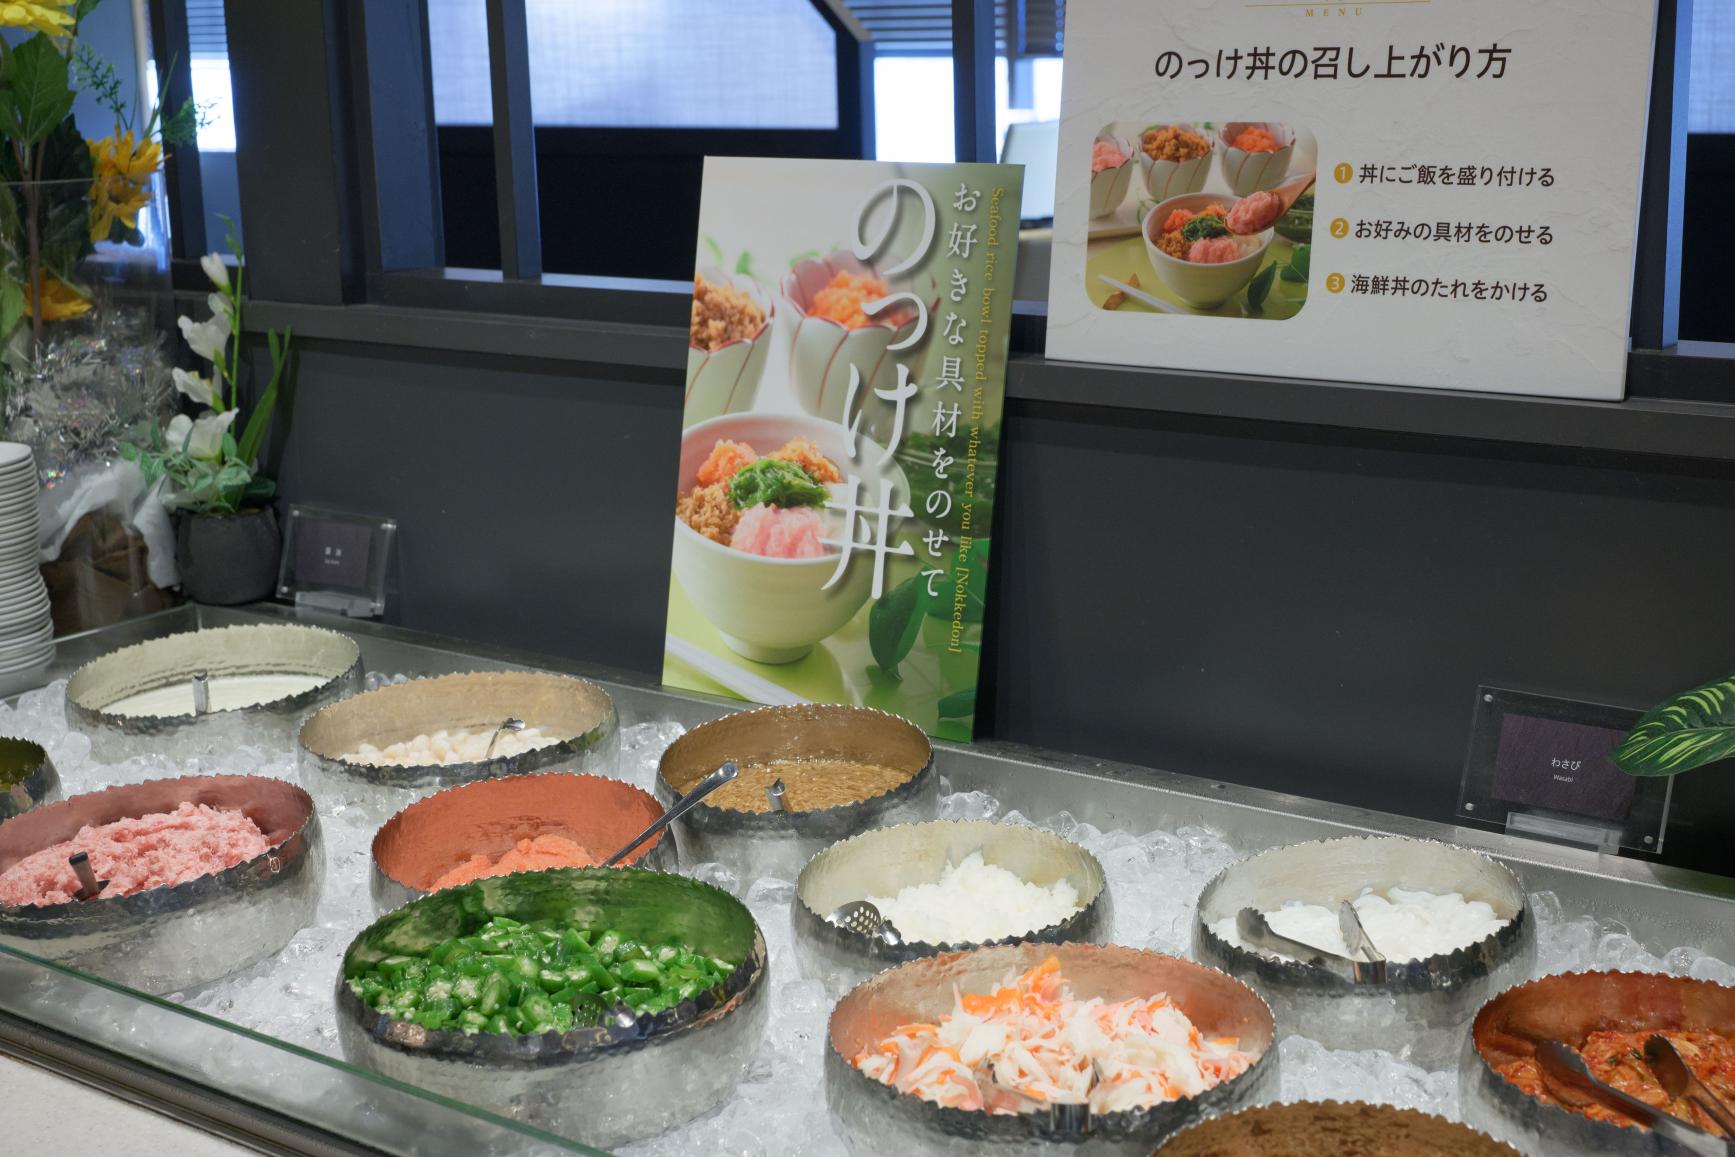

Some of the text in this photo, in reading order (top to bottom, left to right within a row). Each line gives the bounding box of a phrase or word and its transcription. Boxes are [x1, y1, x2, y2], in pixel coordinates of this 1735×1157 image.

[1305, 8, 1364, 17] MENU
[1154, 42, 1513, 80] のっけ丼の召し上がり方
[1359, 163, 1555, 187] 丼にご飯を盛り付ける
[1354, 219, 1554, 245] お好みの具材をのせる
[1350, 274, 1548, 303] 海鮮丼のたれをかける
[816, 178, 936, 600] のっけ丼
[921, 183, 982, 597] お好きな具材をのせて
[948, 187, 1004, 653] Seafood rice bowl topped with whatever you like [Nokkedon]
